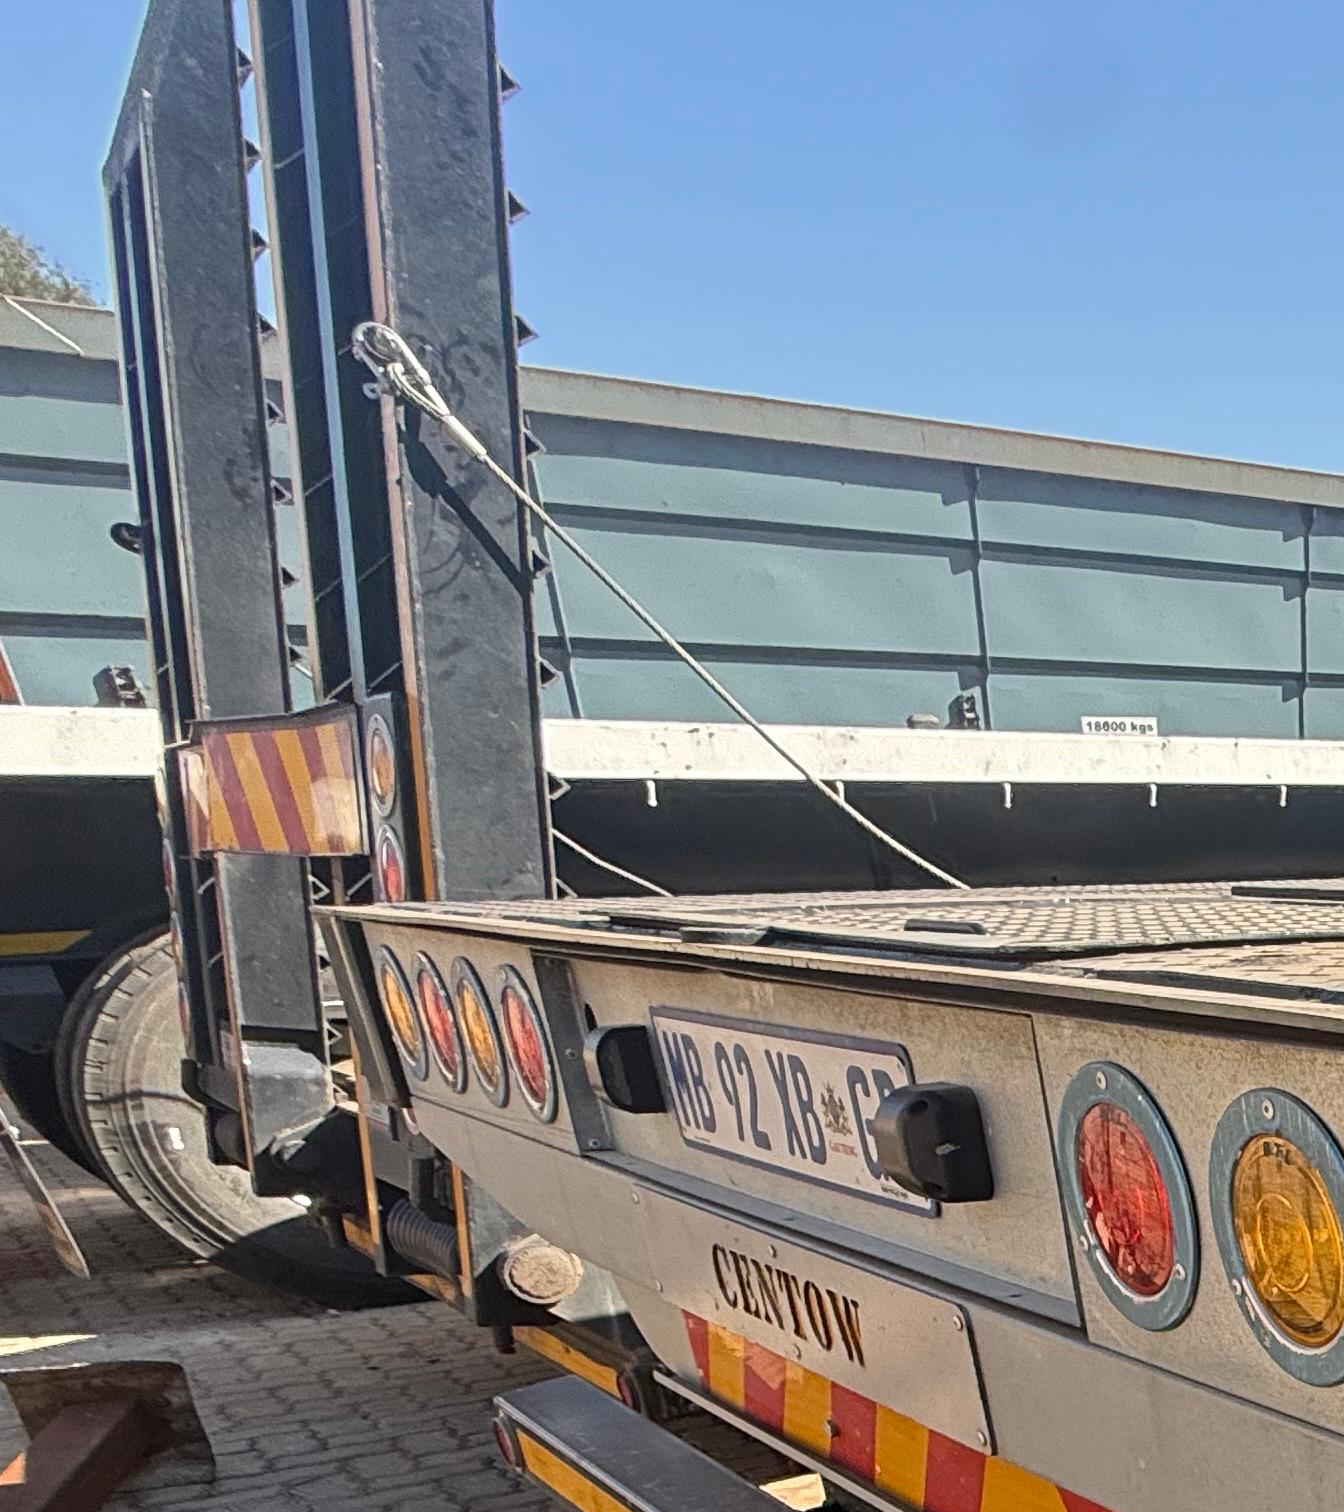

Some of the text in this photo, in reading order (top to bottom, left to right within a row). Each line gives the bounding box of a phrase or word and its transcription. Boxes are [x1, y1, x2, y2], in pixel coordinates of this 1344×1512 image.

[1130, 721, 1154, 734] kgs
[662, 1030, 898, 1180] MB 92 XB G
[712, 1243, 865, 1366] CENTOW
